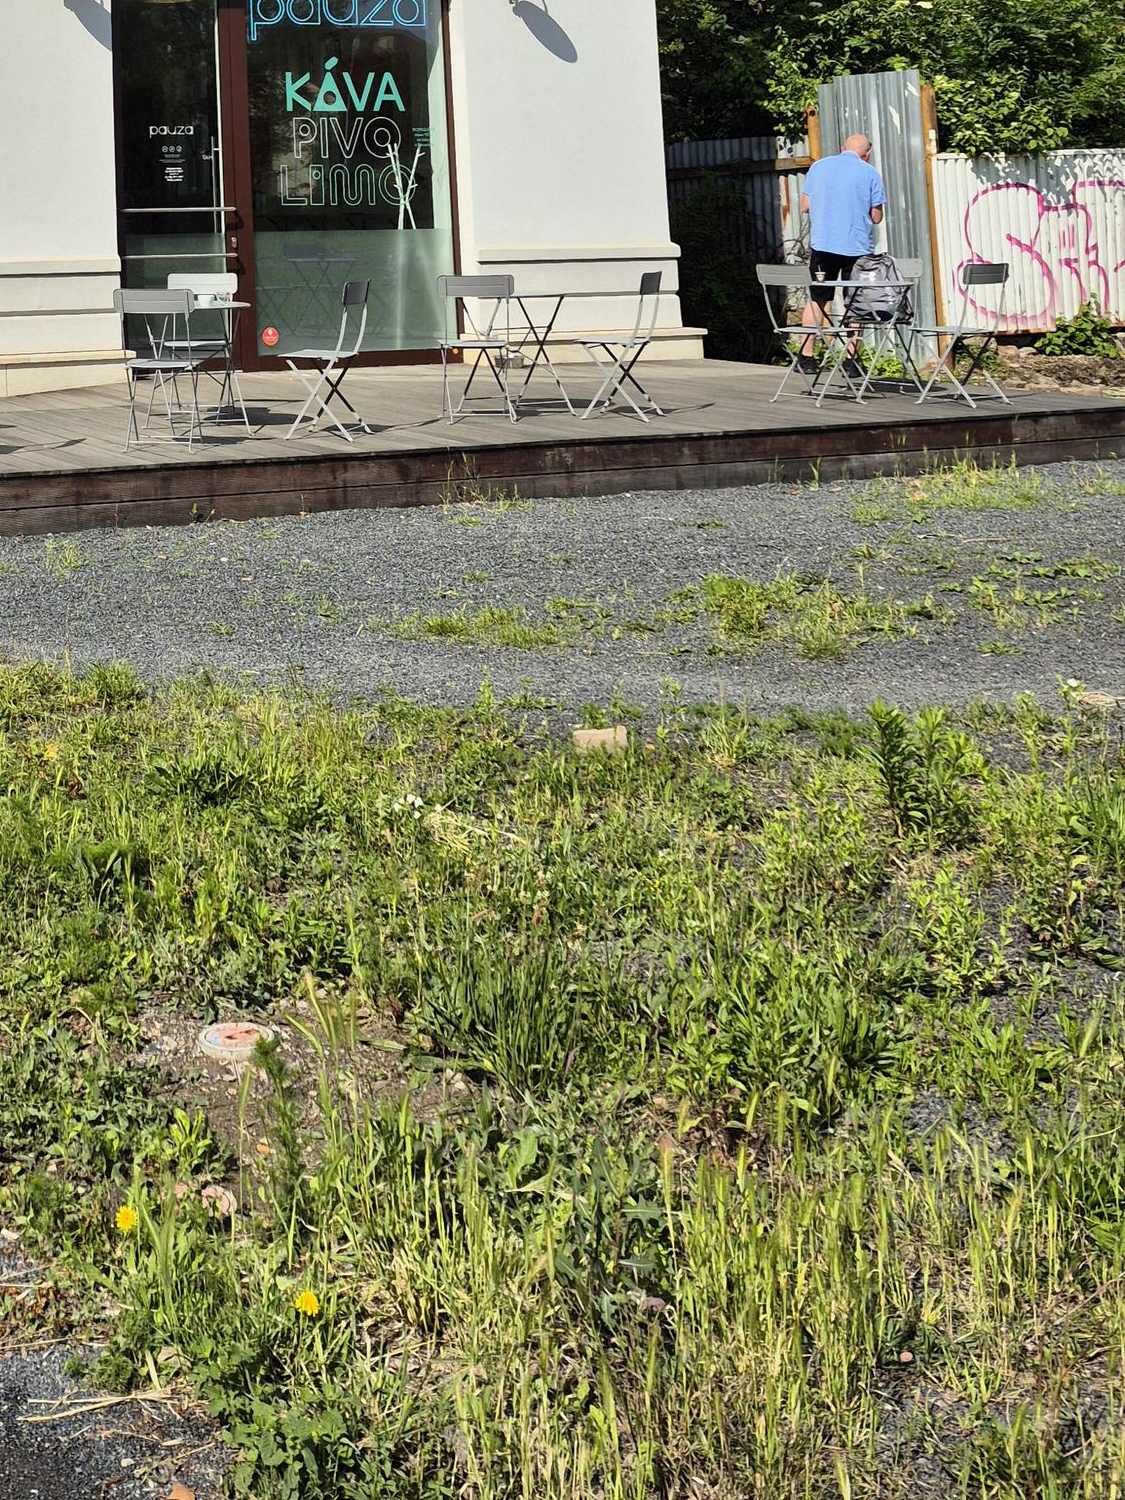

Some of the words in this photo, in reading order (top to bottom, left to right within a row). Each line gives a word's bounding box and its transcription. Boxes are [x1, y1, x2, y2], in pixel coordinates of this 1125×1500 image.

[285, 56, 405, 112] KÁVA
[149, 125, 194, 139] pauza
[293, 116, 402, 159] PIVO
